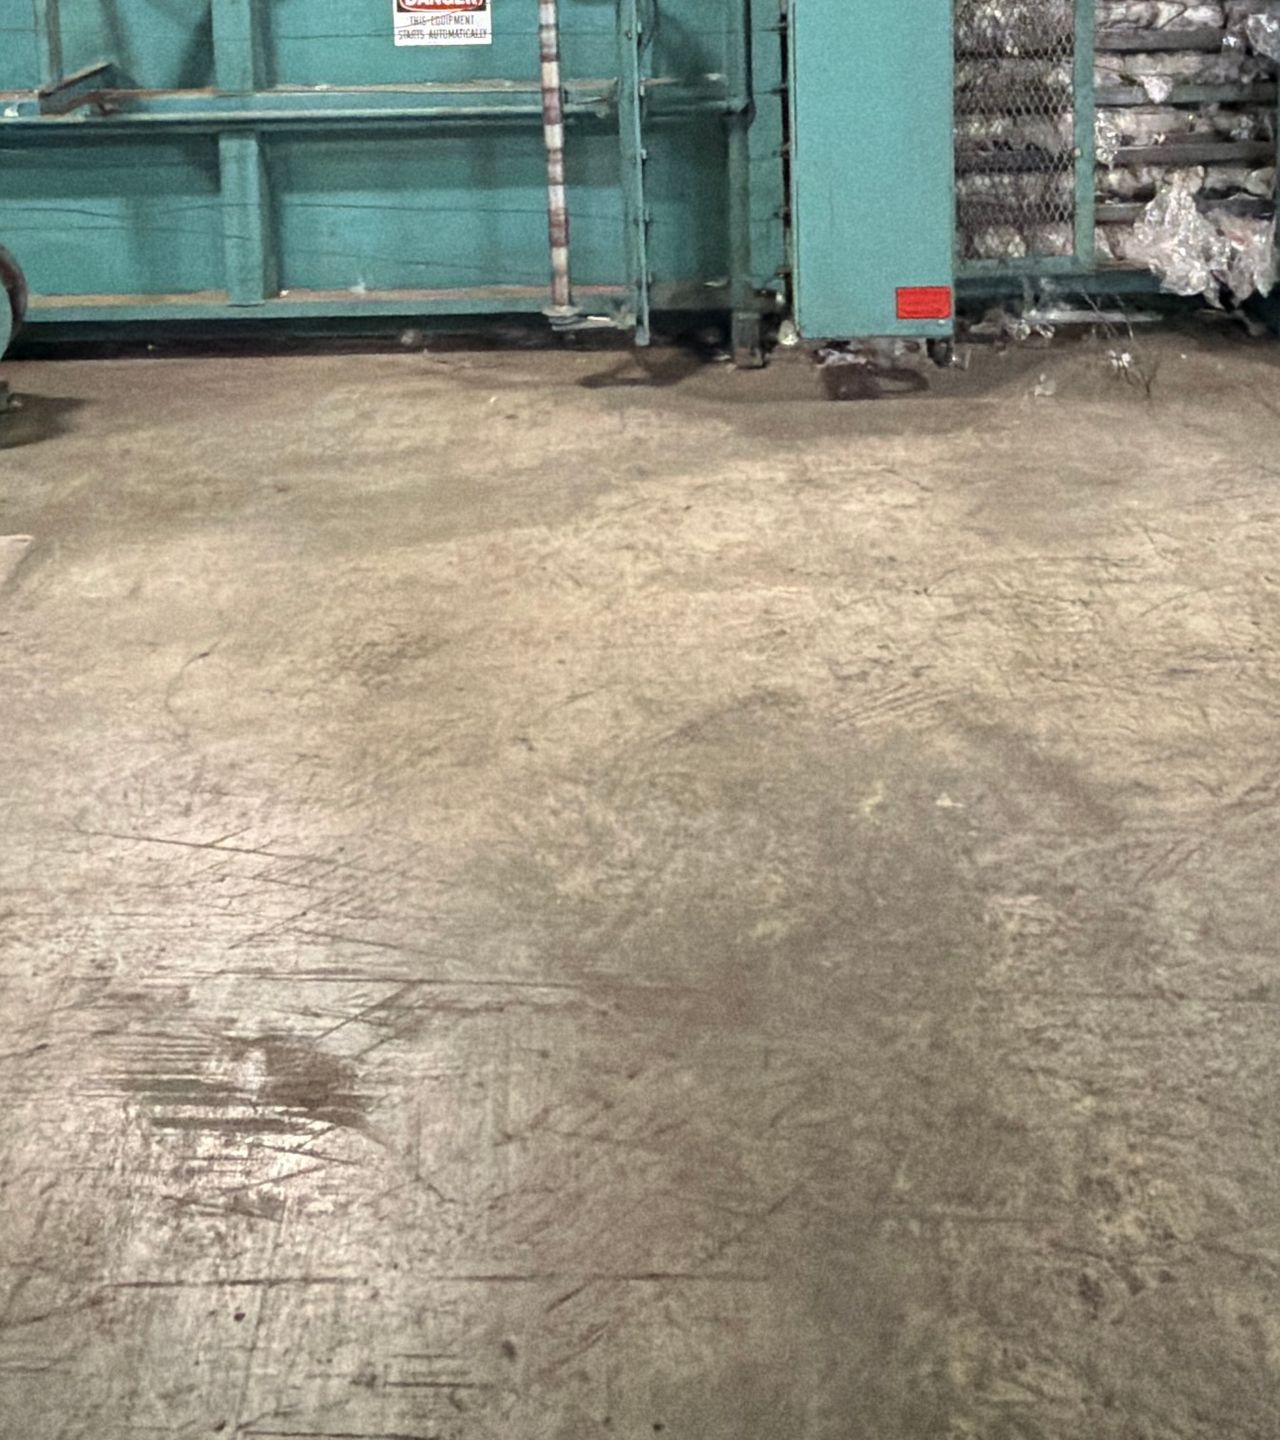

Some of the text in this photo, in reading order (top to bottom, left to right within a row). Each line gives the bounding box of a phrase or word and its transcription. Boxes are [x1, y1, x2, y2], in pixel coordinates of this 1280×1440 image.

[410, 15, 475, 26] THIS EQUIPMENT
[398, 28, 488, 40] STARTS AUTOMATICALLY
